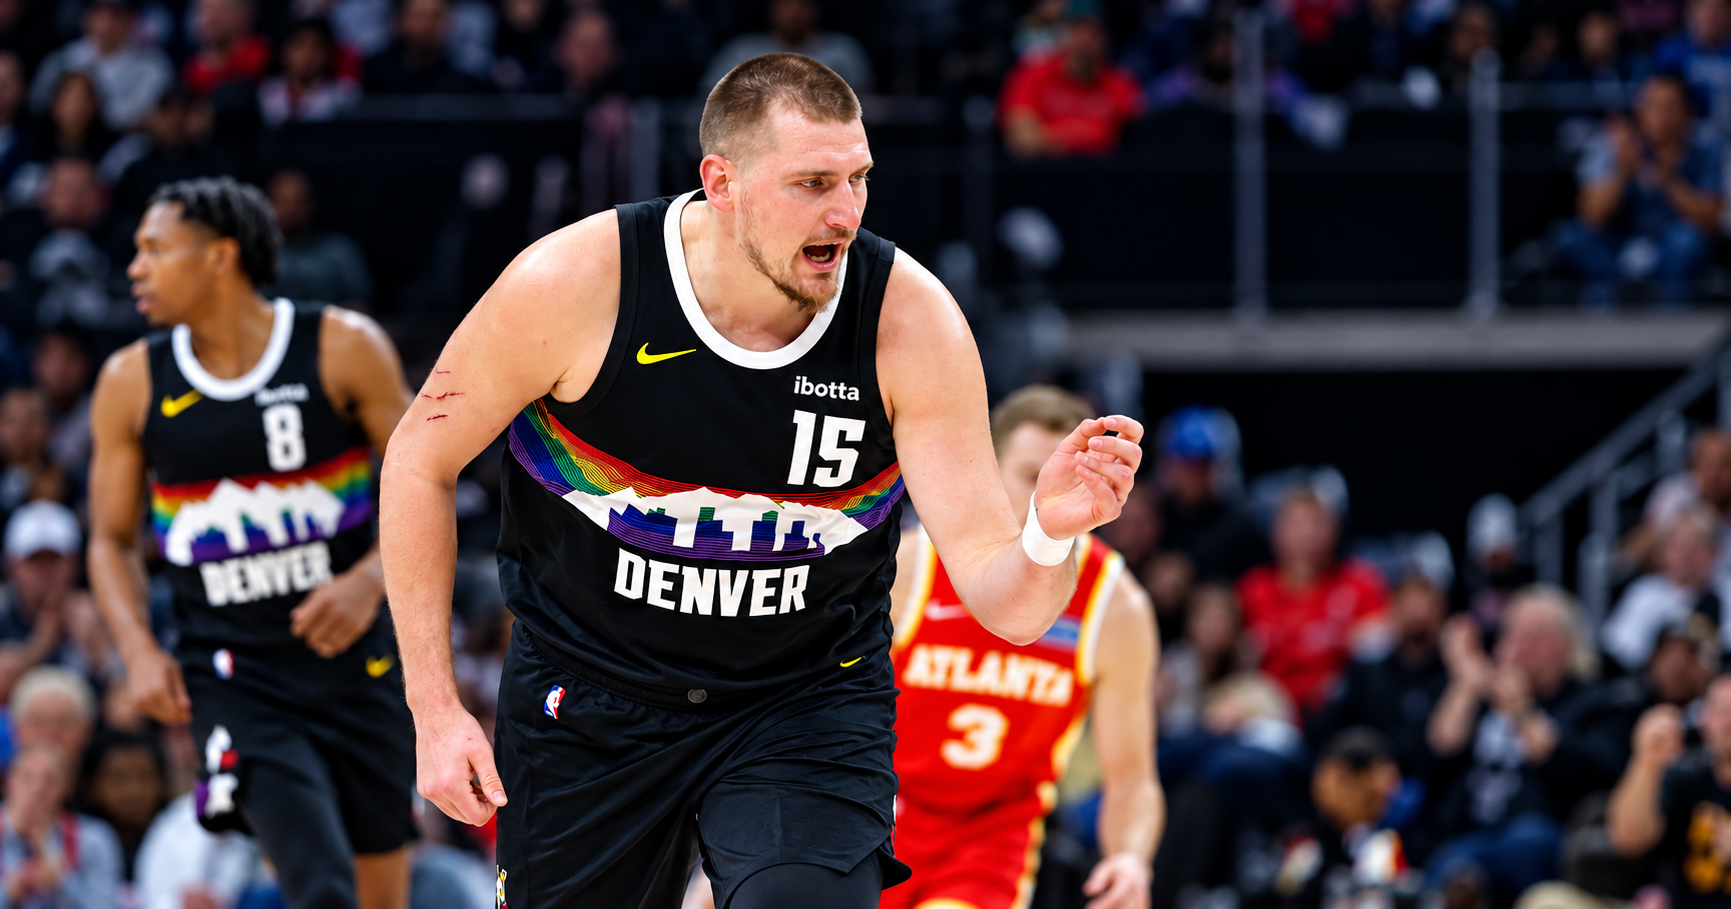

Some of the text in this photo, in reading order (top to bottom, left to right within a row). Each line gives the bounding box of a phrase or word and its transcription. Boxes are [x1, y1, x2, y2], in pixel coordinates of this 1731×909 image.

[794, 375, 860, 401] ibotta
[263, 402, 306, 472] 8
[787, 409, 866, 488] 15
[201, 541, 333, 607] DENVER
[614, 547, 810, 617] DENVER
[903, 643, 1074, 707] ATLANTA
[941, 703, 1010, 771] 3
